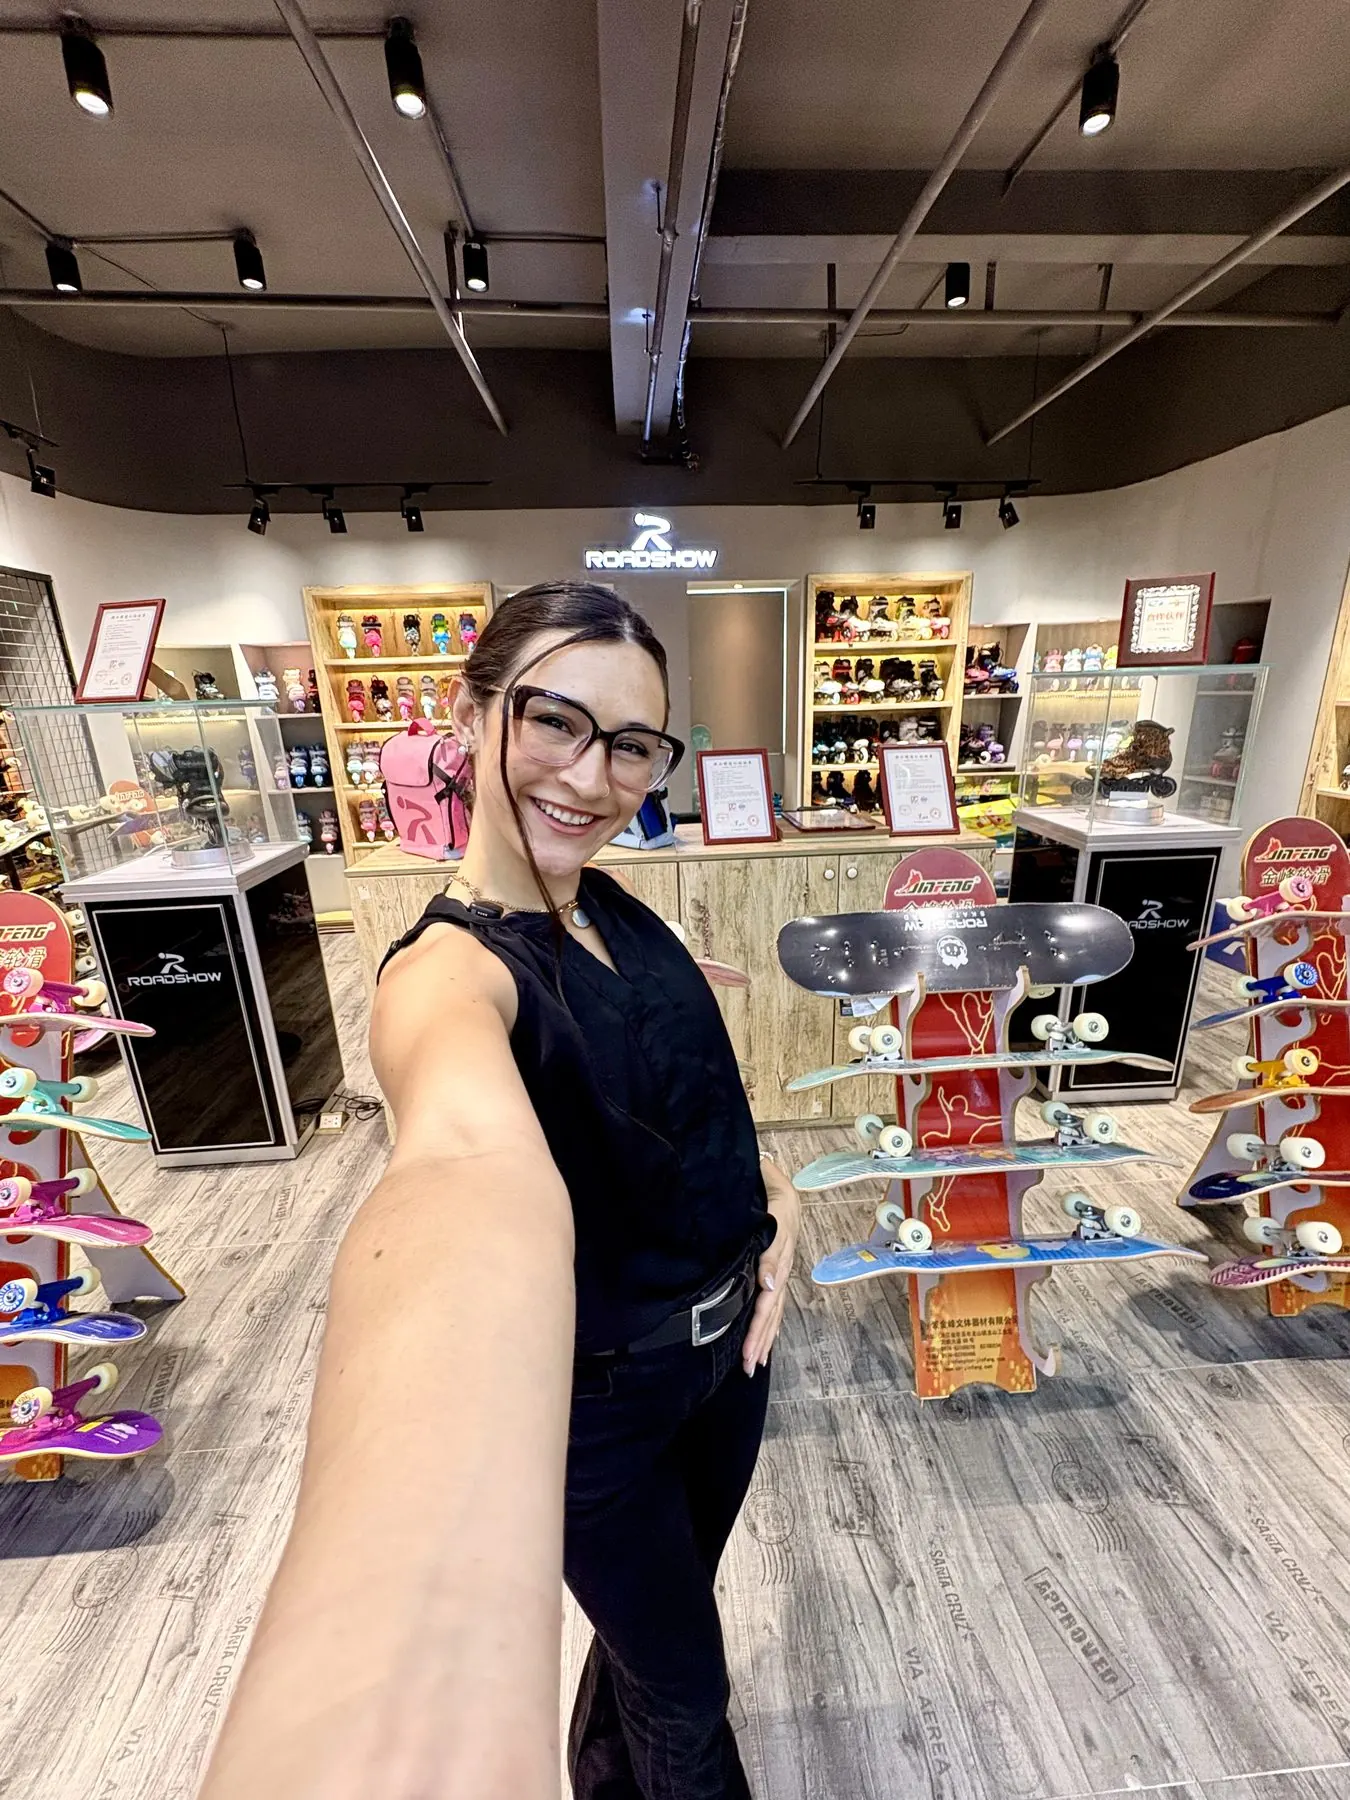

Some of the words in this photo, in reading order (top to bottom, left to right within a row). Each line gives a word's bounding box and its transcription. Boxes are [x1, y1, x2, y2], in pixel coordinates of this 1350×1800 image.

[585, 550, 718, 568] ROADSHOW
[1267, 846, 1332, 861] JINFENG
[906, 878, 976, 895] JINFENG
[1127, 919, 1190, 930] ADSHOW
[127, 971, 222, 987] ROADSHOW
[1252, 1516, 1283, 1555] SANTA
[1281, 1556, 1318, 1597] CRUZ
[929, 1549, 953, 1588] SANTA
[945, 1591, 972, 1633] CRUZ
[222, 1614, 252, 1660] SANTA
[1033, 1579, 1119, 1684] APPROVED
[201, 1664, 232, 1710] CRUZ
[1265, 1610, 1290, 1642] VIA
[1293, 1654, 1350, 1730] AEREA
[905, 1646, 924, 1681] VIA
[918, 1695, 951, 1776] AEREA
[117, 1724, 147, 1762] VIA
